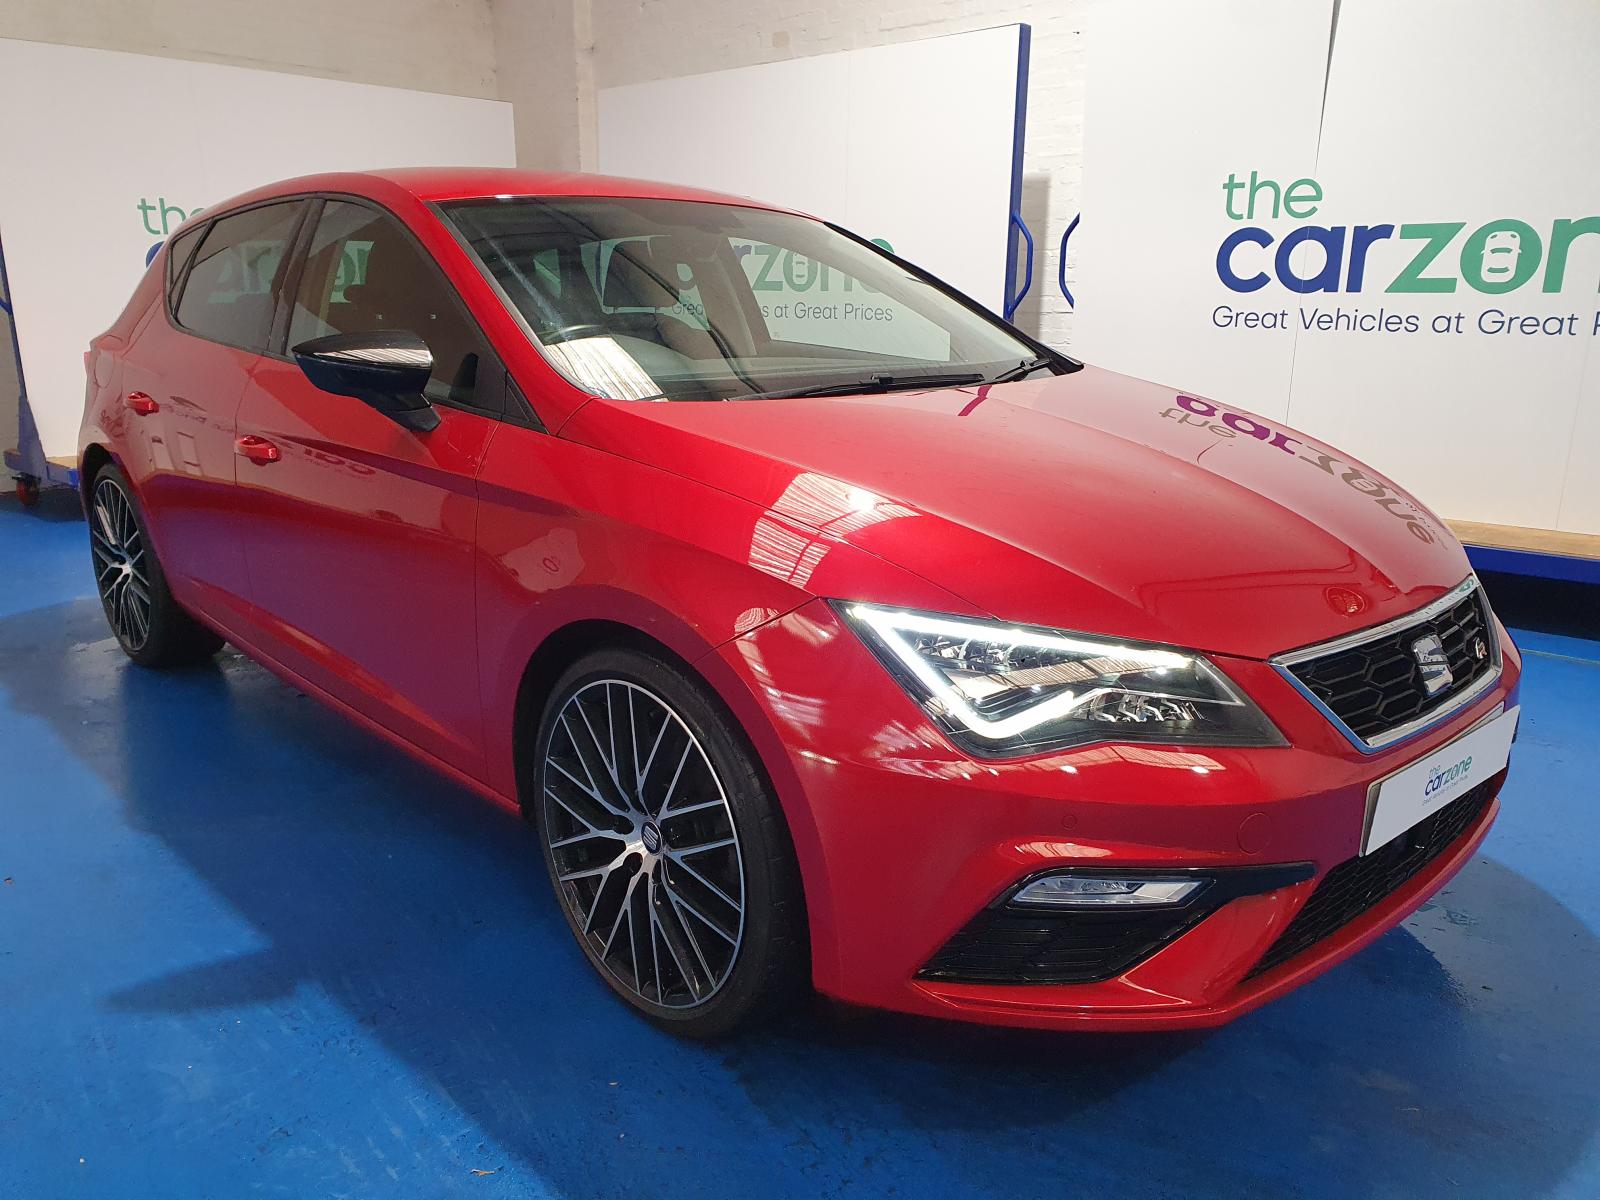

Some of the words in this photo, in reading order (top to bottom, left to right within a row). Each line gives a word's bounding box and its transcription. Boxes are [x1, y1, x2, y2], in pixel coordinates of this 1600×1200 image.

[1222, 170, 1323, 220] the
[137, 197, 205, 235] th
[774, 304, 790, 319] at
[794, 301, 838, 320] Great
[844, 303, 893, 321] Prices
[1212, 305, 1289, 331] Great
[1299, 306, 1420, 333] Vehicles
[1431, 312, 1465, 335] at
[1478, 309, 1579, 337] Great
[1425, 755, 1473, 796] carzone
